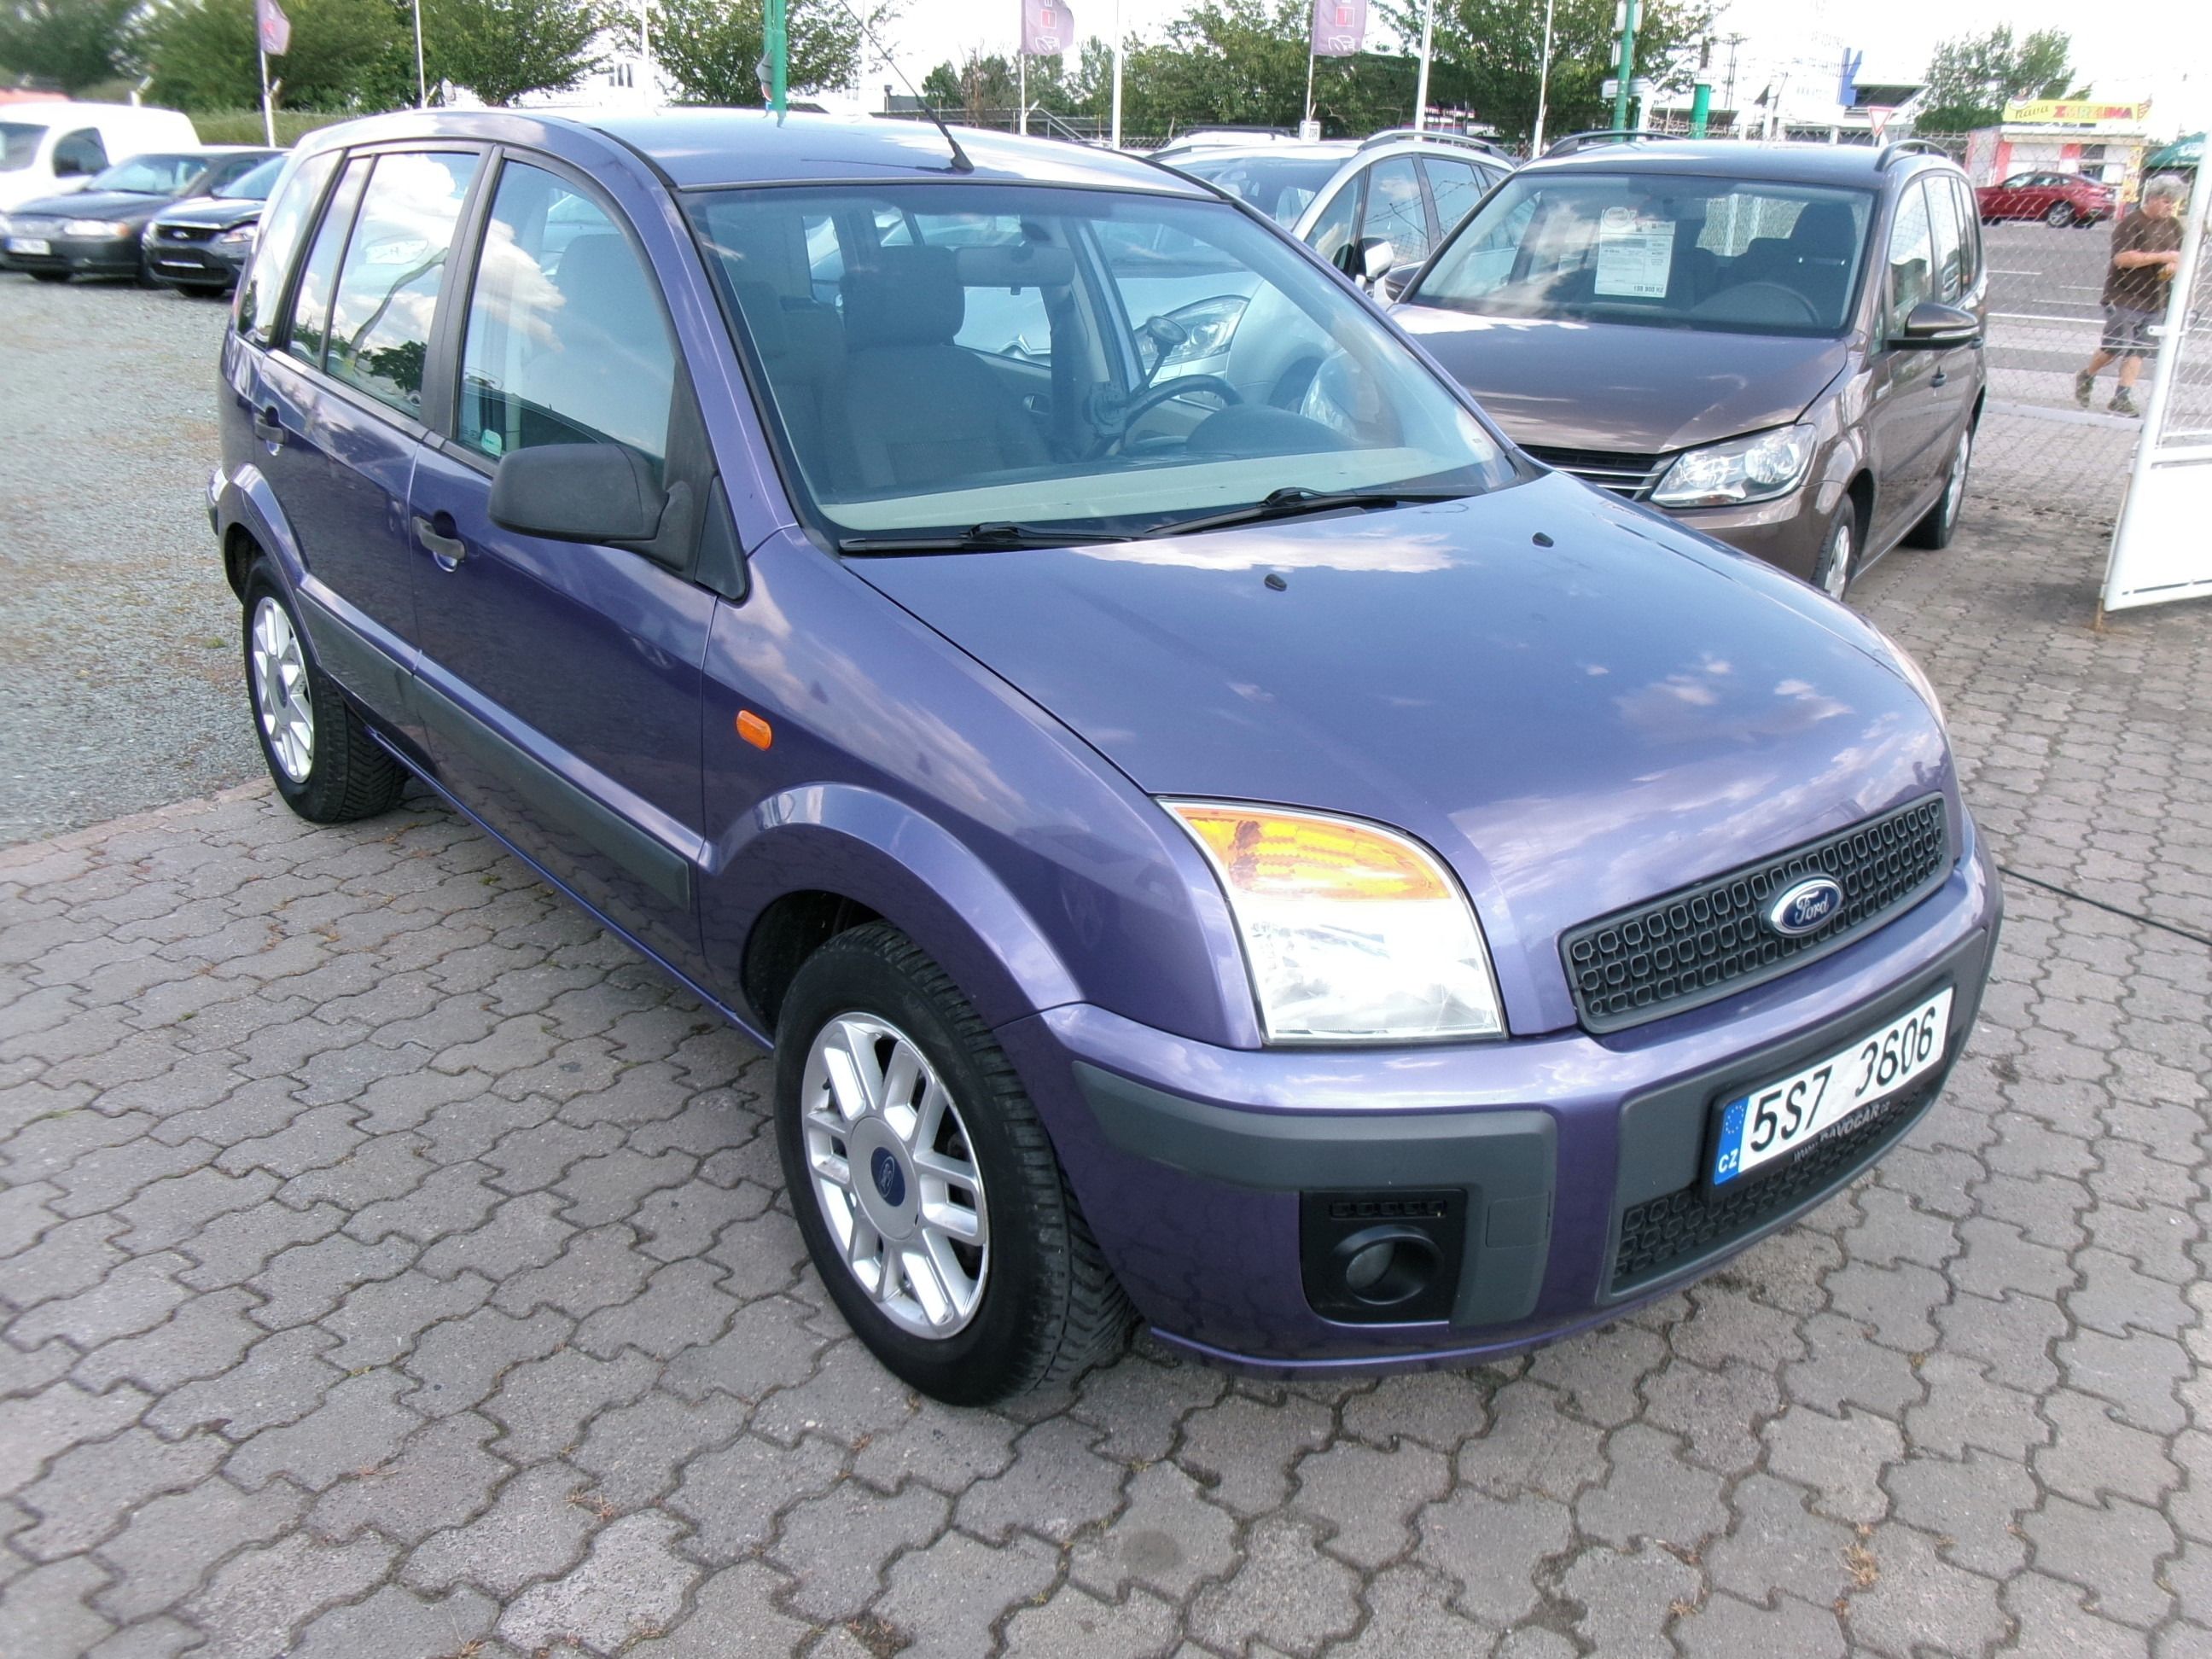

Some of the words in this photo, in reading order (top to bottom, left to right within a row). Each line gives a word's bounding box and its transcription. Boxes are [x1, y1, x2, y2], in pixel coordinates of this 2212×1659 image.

[1795, 890, 1829, 924] Ford
[1750, 1064, 1833, 1152] 5S7
[1855, 1006, 1936, 1097] 3606
[1718, 1148, 1738, 1173] CZ
